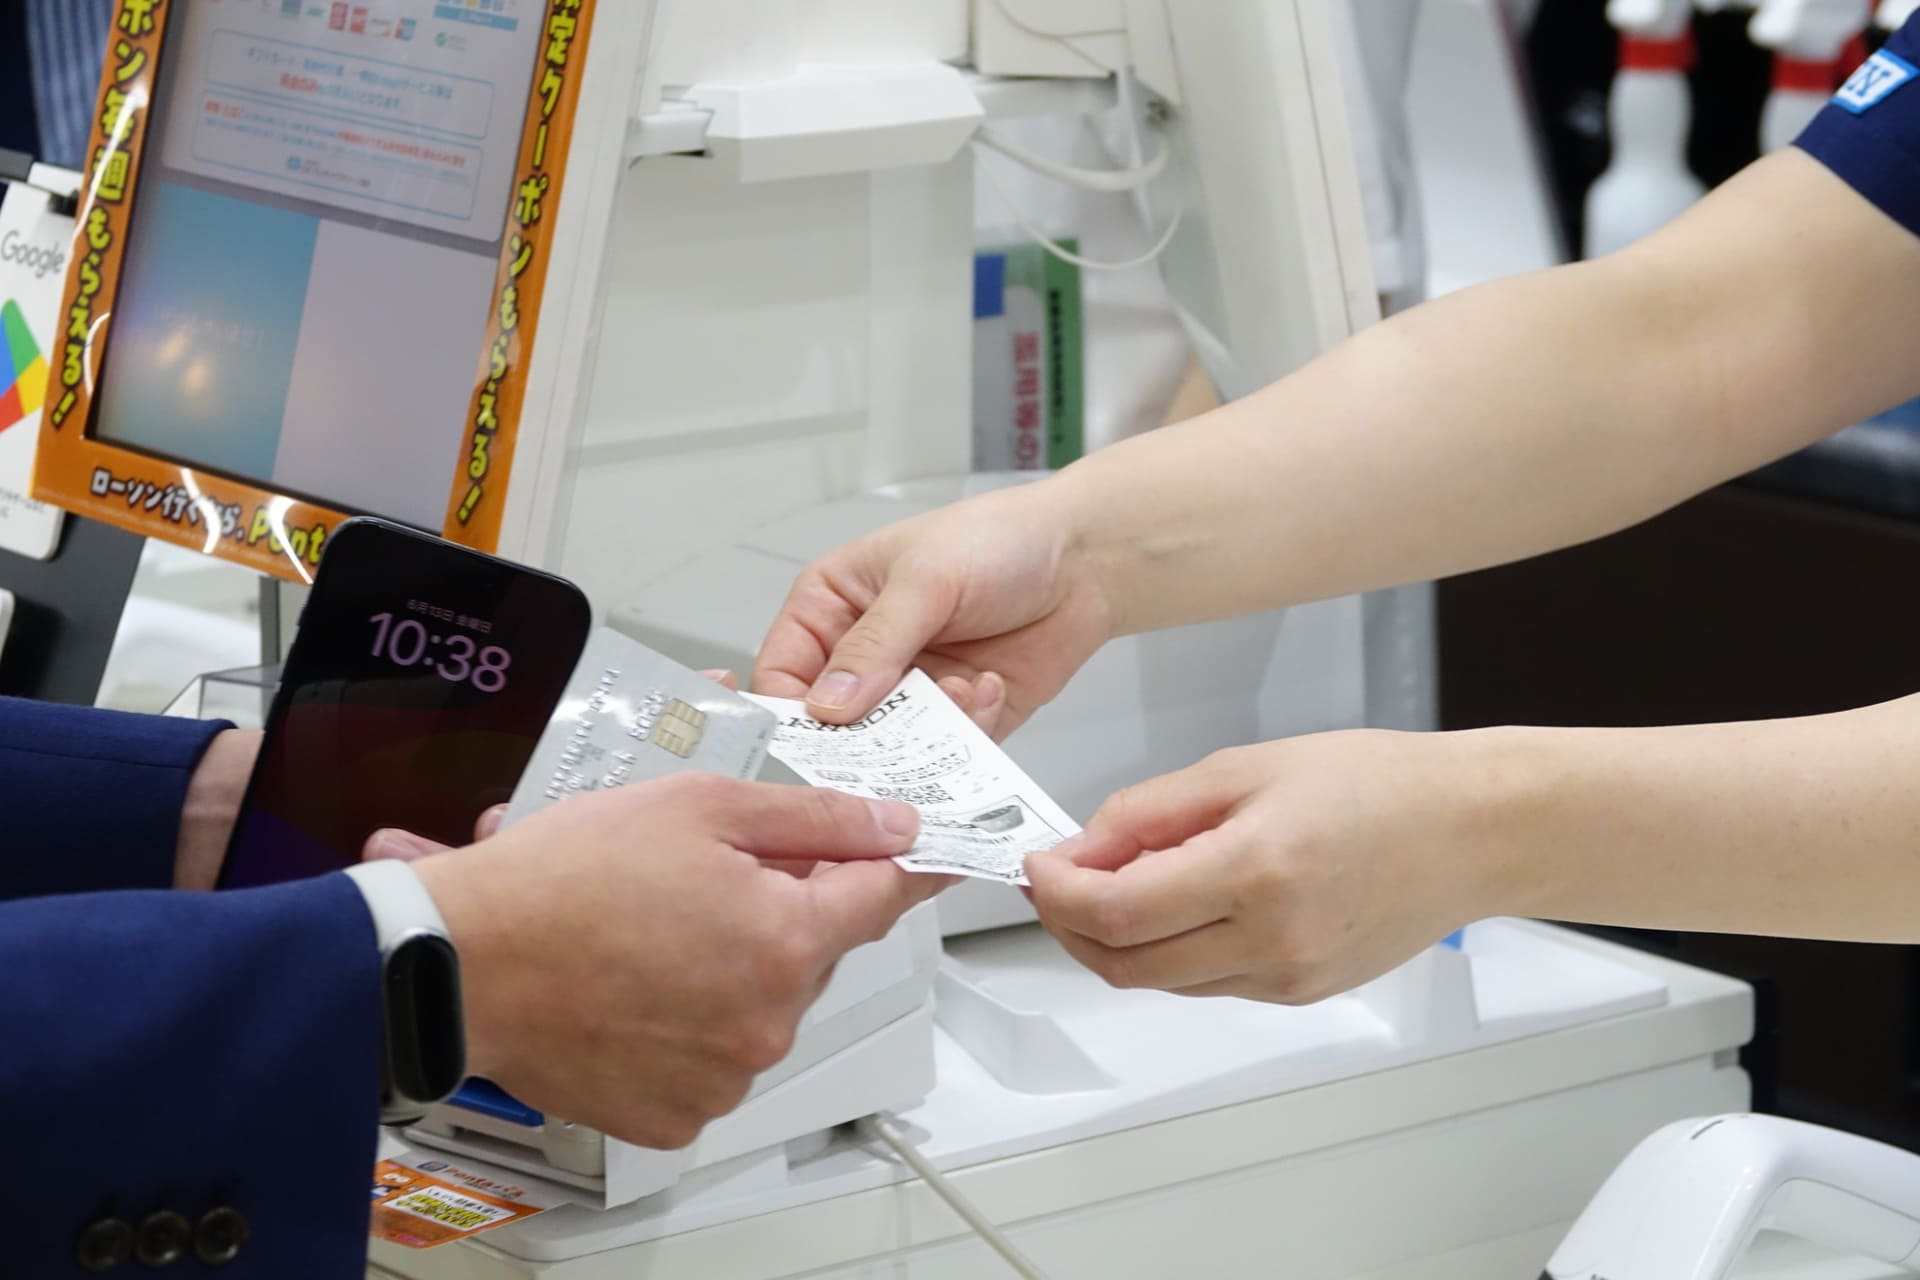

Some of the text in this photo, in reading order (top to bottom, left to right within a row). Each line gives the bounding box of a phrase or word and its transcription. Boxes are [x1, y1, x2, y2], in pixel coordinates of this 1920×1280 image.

[1, 229, 65, 279] Google
[457, 0, 581, 523] 定クーポンもらえる！
[368, 612, 512, 692] 10:38
